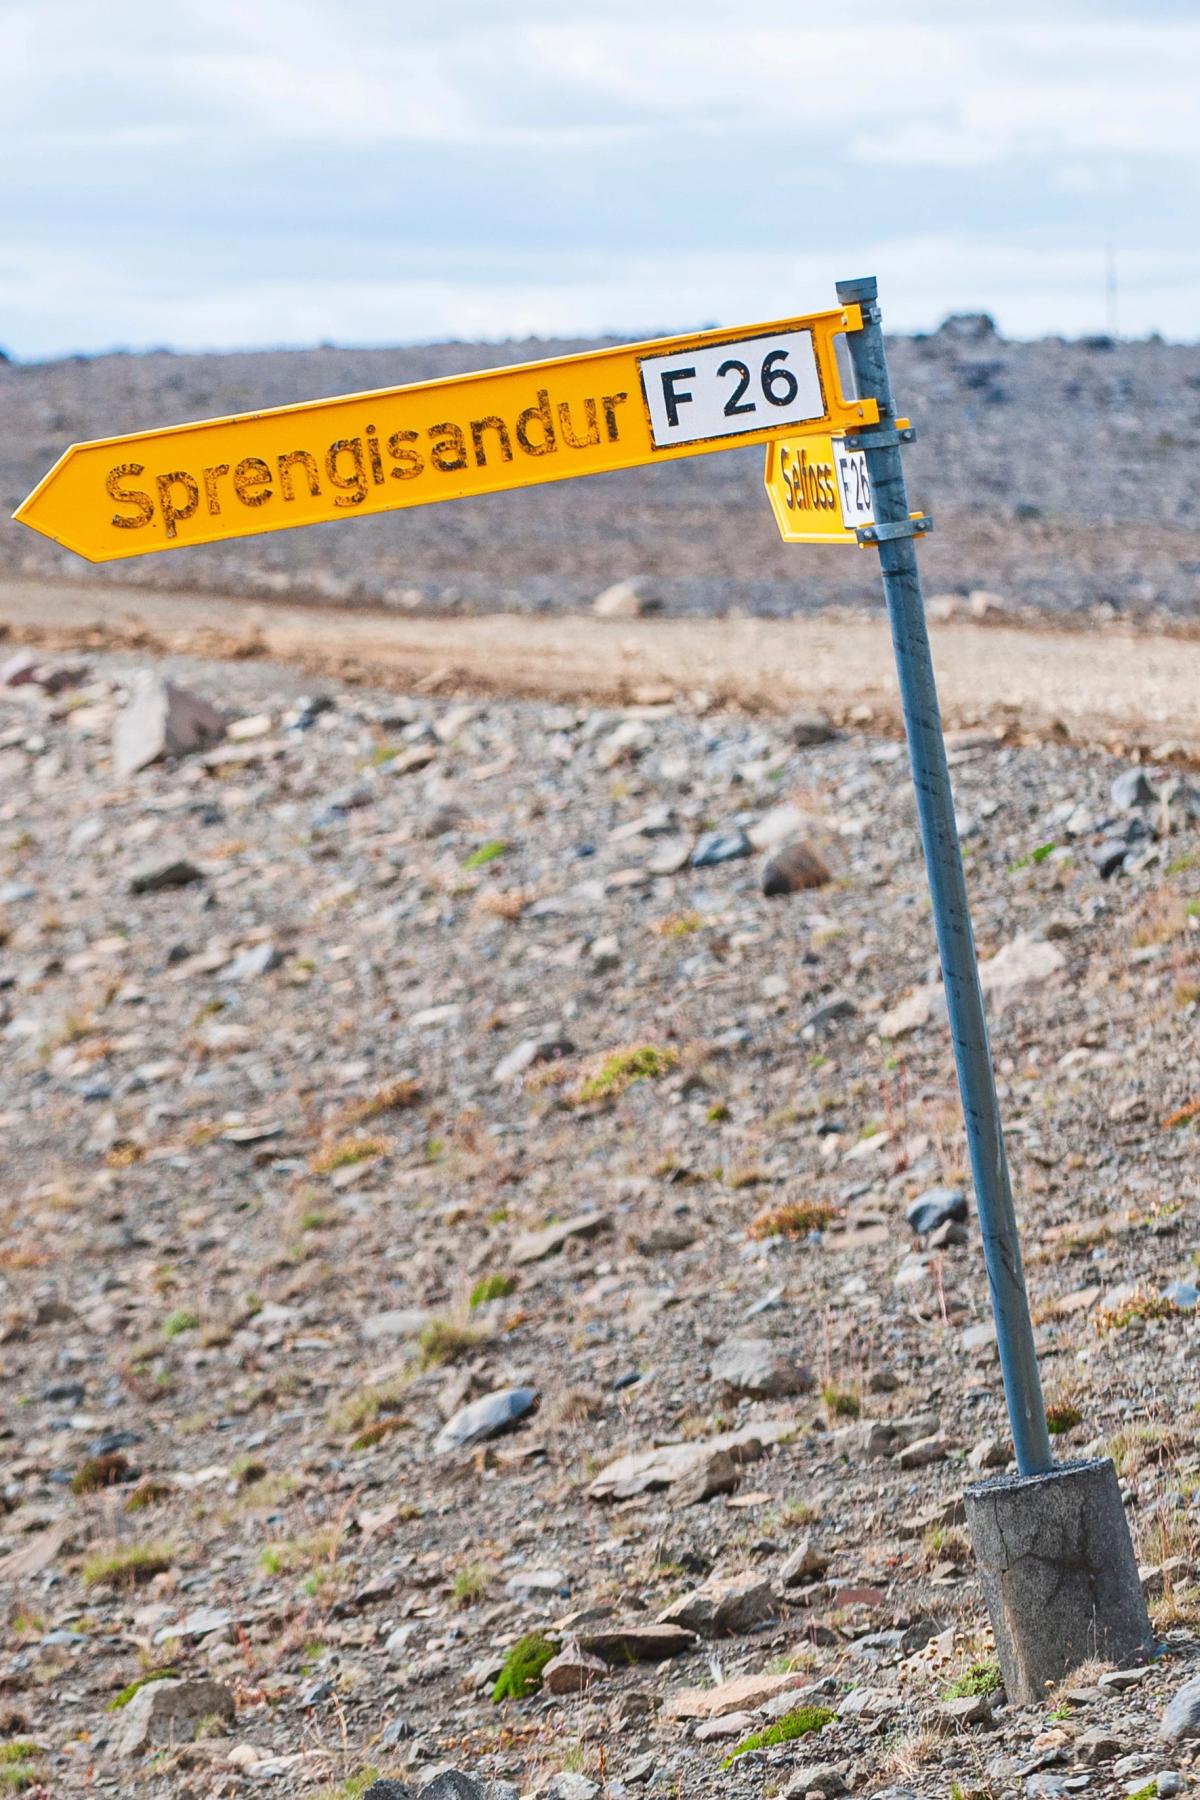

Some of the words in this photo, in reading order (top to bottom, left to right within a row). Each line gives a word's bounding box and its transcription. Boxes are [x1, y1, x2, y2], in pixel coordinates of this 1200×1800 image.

[105, 389, 628, 537] Sprengisandur
[660, 367, 696, 427] F
[716, 350, 799, 417] 26
[781, 448, 836, 512] Selfoss
[839, 458, 851, 513] F
[850, 455, 871, 511] 26
